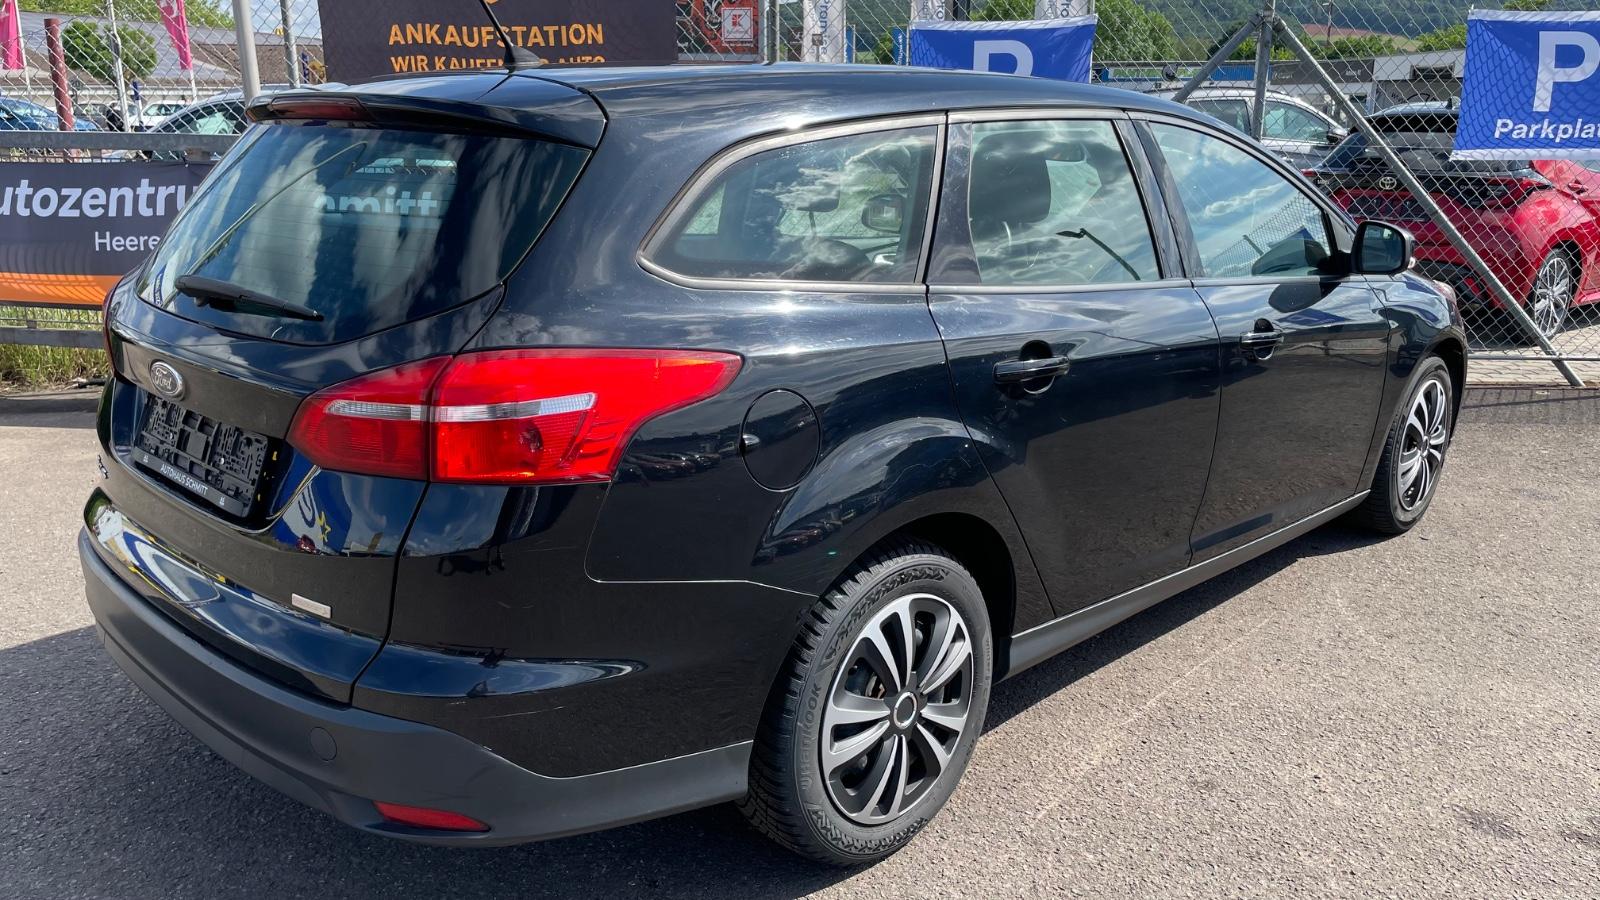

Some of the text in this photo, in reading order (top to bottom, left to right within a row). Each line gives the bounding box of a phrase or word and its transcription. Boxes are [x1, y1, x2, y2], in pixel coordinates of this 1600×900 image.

[388, 23, 604, 48] ANKAUFSTATION
[390, 55, 428, 73] WIR
[434, 55, 505, 71] KAUFE
[1533, 31, 1600, 112] P
[160, 463, 208, 496] AUTOHAUS SCHMITT
